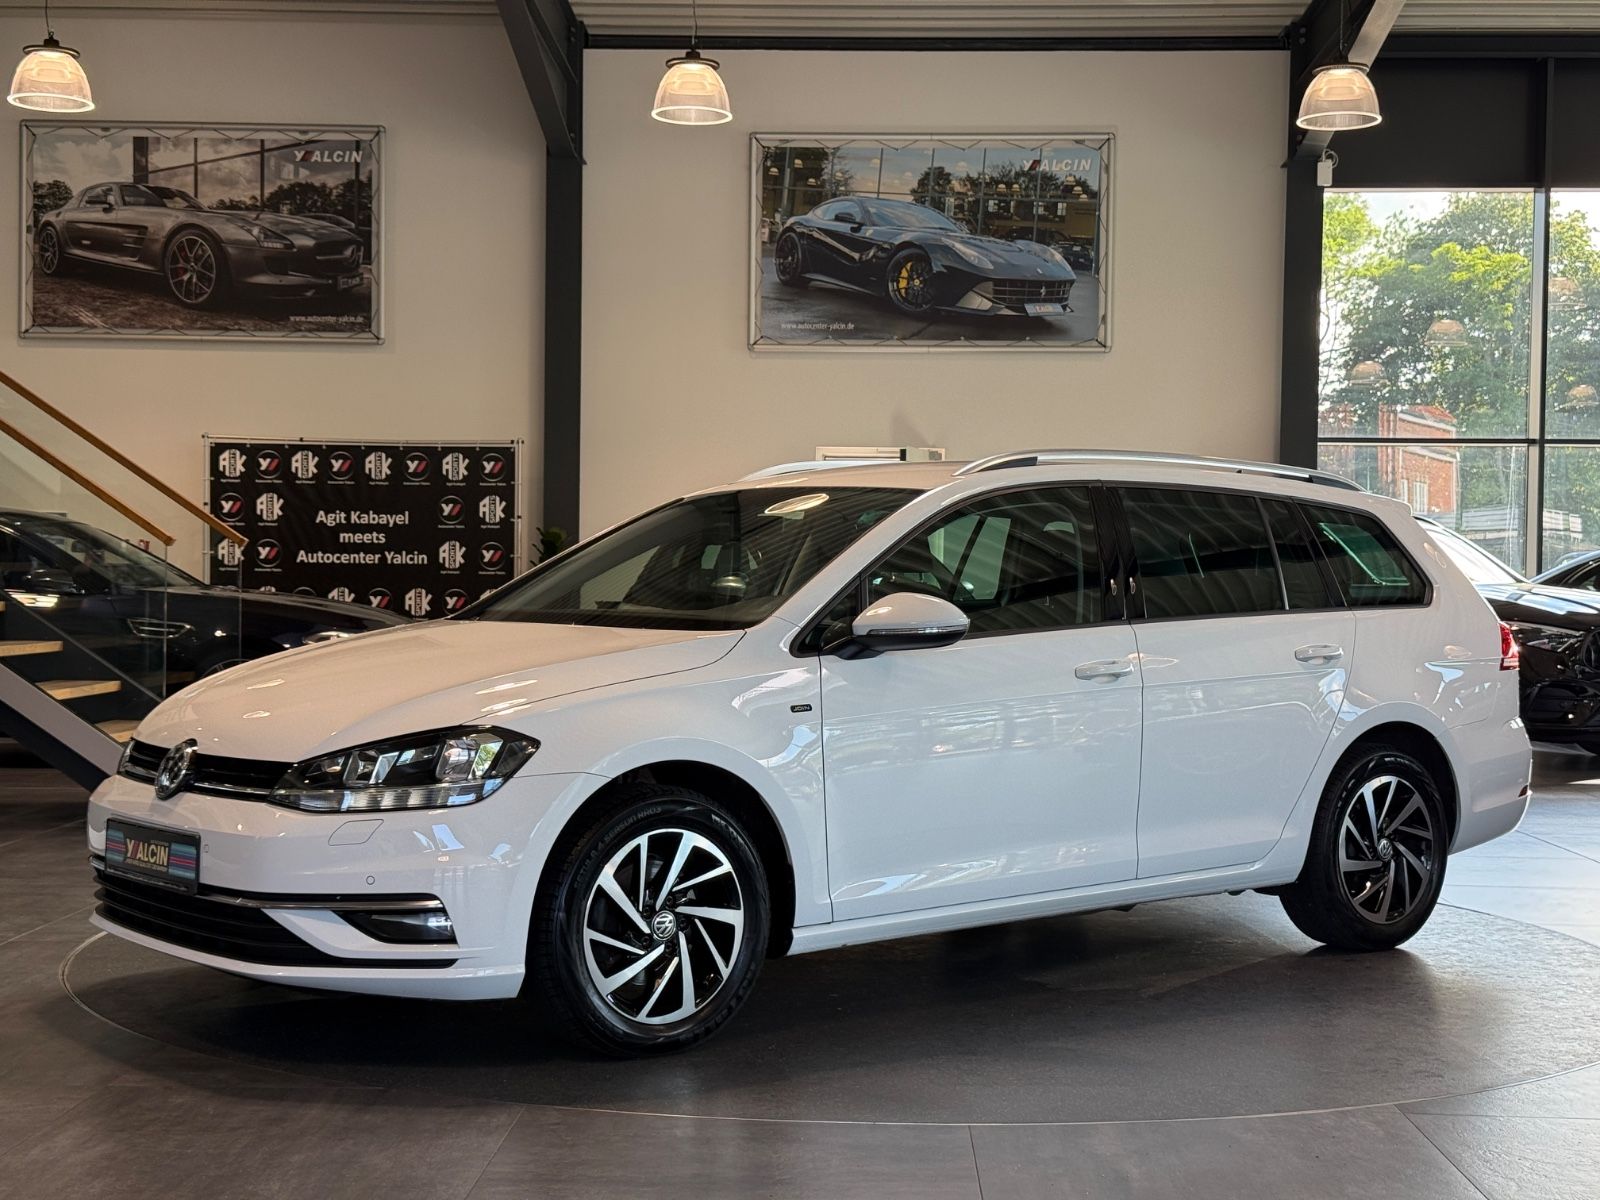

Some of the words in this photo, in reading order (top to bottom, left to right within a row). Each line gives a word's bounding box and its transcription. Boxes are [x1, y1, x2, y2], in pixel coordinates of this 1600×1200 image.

[781, 322, 855, 331] www.autocenter-yalcin.de
[315, 510, 347, 526] Agit
[350, 510, 409, 527] Kabayel
[339, 531, 386, 543] meets
[296, 549, 381, 564] Autocenter
[384, 550, 428, 564] Yalcin
